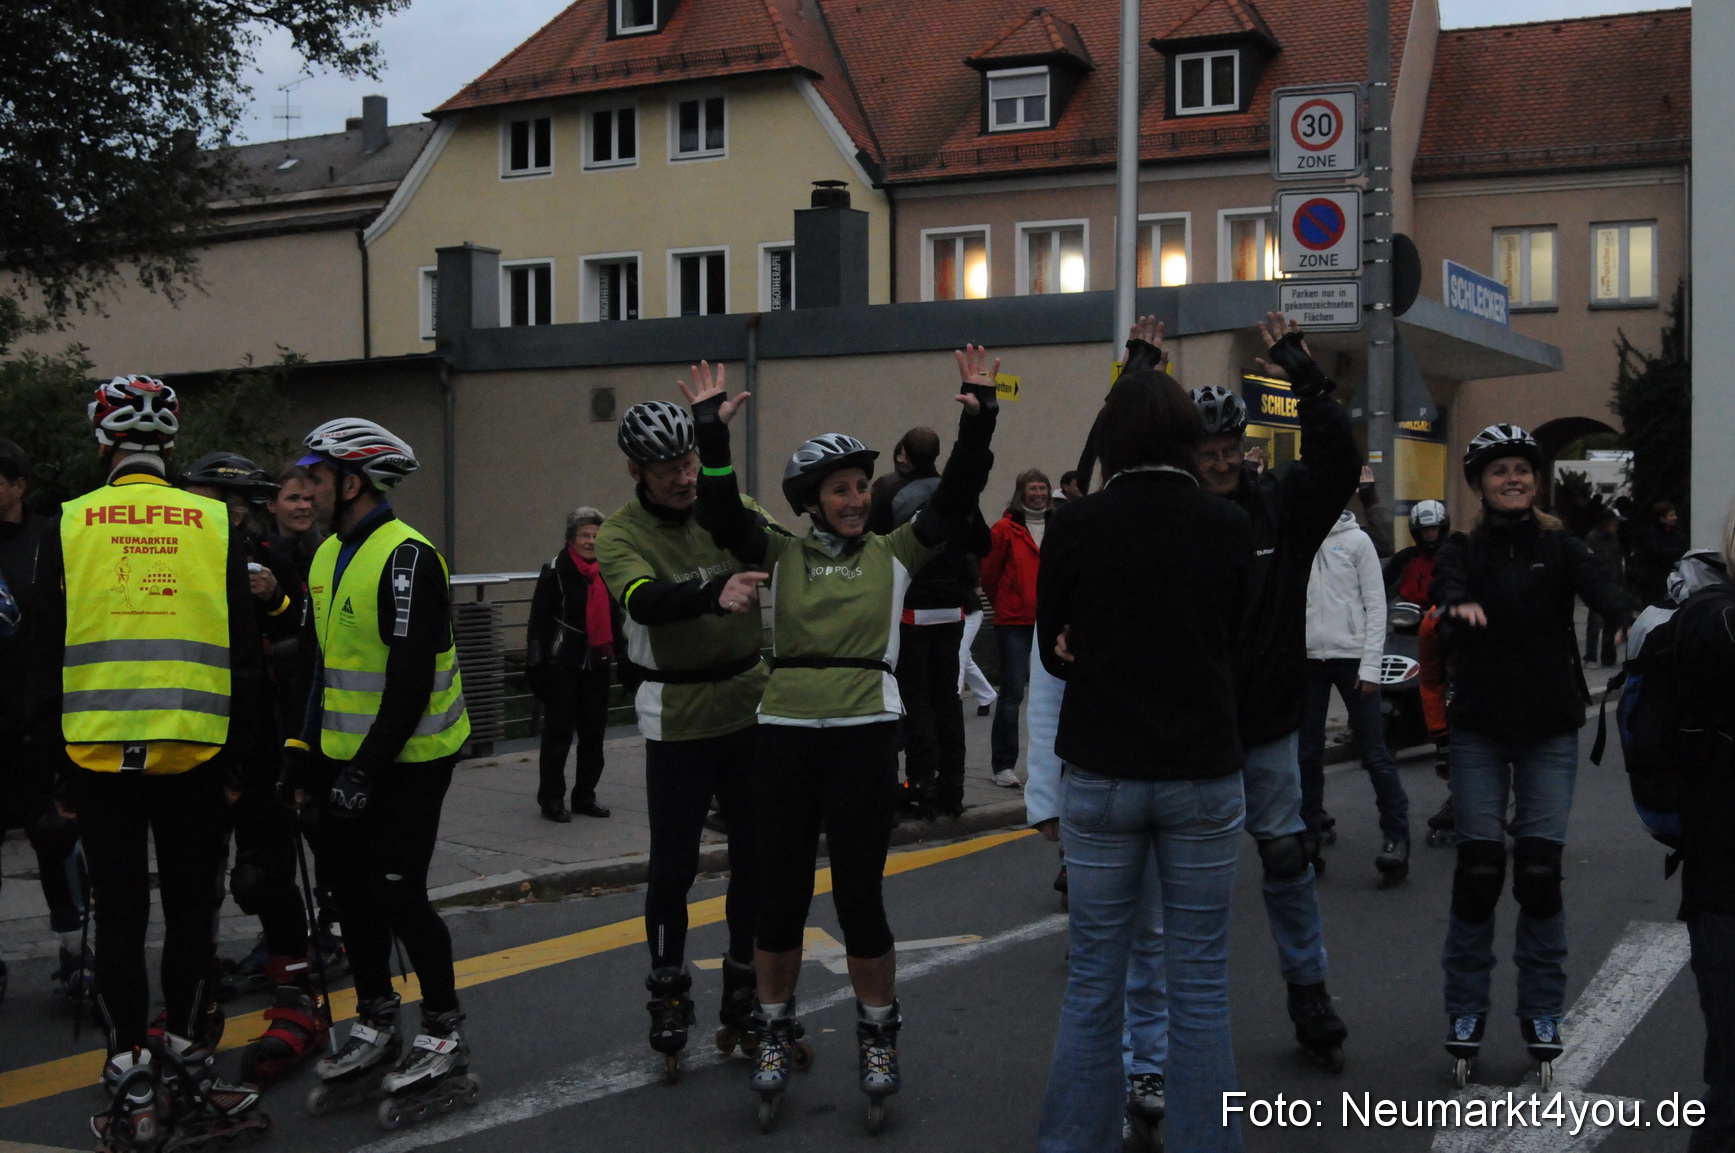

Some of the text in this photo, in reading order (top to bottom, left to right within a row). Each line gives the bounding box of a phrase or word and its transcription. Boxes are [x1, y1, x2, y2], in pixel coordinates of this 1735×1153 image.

[1301, 113, 1332, 138] 30
[1297, 155, 1337, 169] ZONE
[1299, 254, 1339, 267] ZONE
[771, 252, 781, 310] ERGOTHERAPIE
[1291, 288, 1347, 299] Parken nur in
[1450, 274, 1507, 325] SCHLECKER
[1284, 300, 1354, 312] gekennzeichneten
[1303, 312, 1334, 321] Flächen
[1261, 393, 1299, 418] SCHLEC
[85, 505, 203, 529] HELFER
[111, 536, 179, 545] NEUMARKTER
[123, 545, 179, 555] STADTLAUF
[834, 566, 863, 580] POLES
